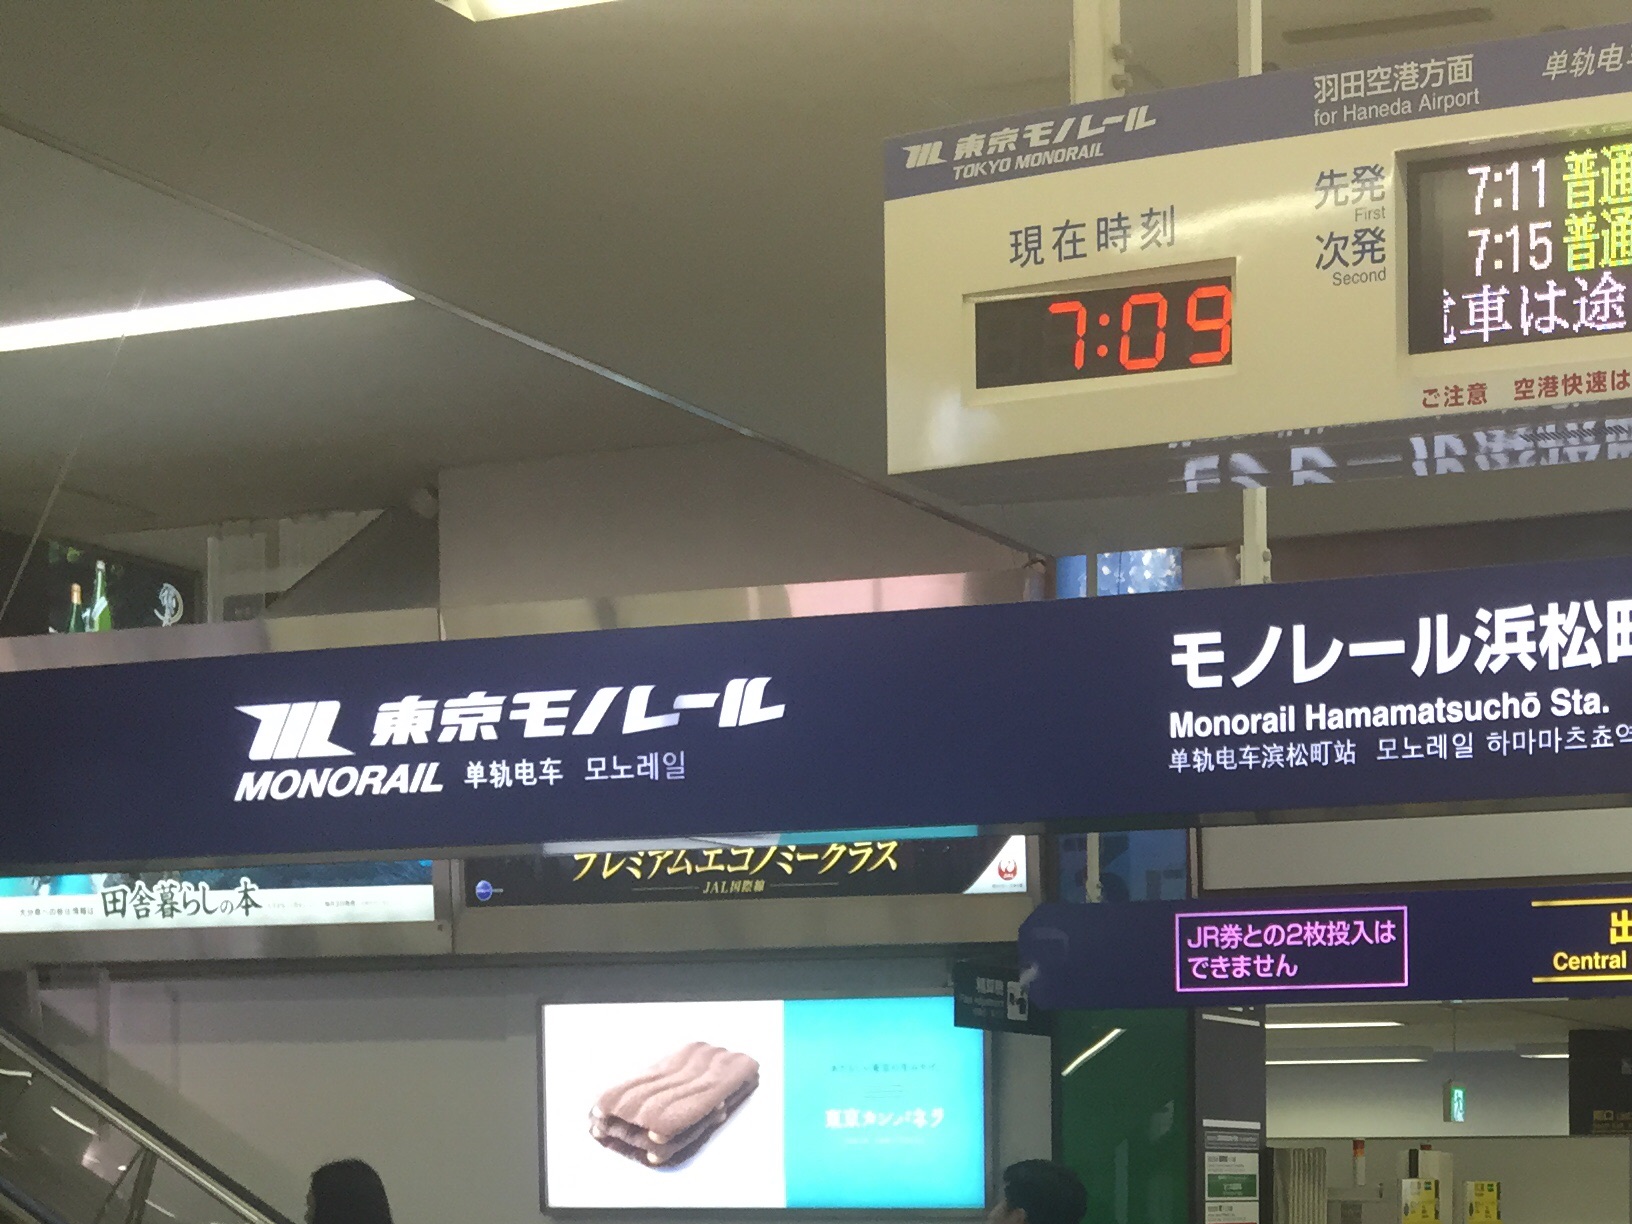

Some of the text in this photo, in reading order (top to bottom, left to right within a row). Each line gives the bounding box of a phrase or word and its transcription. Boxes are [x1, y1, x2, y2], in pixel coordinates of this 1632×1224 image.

[1314, 53, 1474, 104] 羽田空港方面
[1314, 87, 1480, 127] for Haneda Airport
[954, 105, 1156, 161] 東京モノレール
[953, 143, 1104, 181] TOKYO MONORAIL
[1315, 163, 1386, 211] 先発
[1469, 158, 1547, 215] 7:11
[1009, 205, 1177, 268] 現在時刻
[1355, 206, 1386, 222] First
[1315, 225, 1386, 271] 次発
[1469, 221, 1553, 277] 7:15
[1332, 267, 1387, 287] Second
[1048, 284, 1233, 371] 7:09
[1421, 384, 1487, 410] ご注意
[370, 676, 786, 747] 東京モノレール
[1169, 686, 1610, 740] Monorail Hamamatsuchō Sta.
[1376, 730, 1475, 763] 모노레일
[233, 751, 686, 802] MONORAIL 单轨电车 모노레일
[101, 876, 263, 921] 田舎暮らしの本
[1187, 920, 1397, 949] JR券との2枚投入は
[1187, 954, 1299, 980] できません
[1553, 950, 1627, 972] Central
